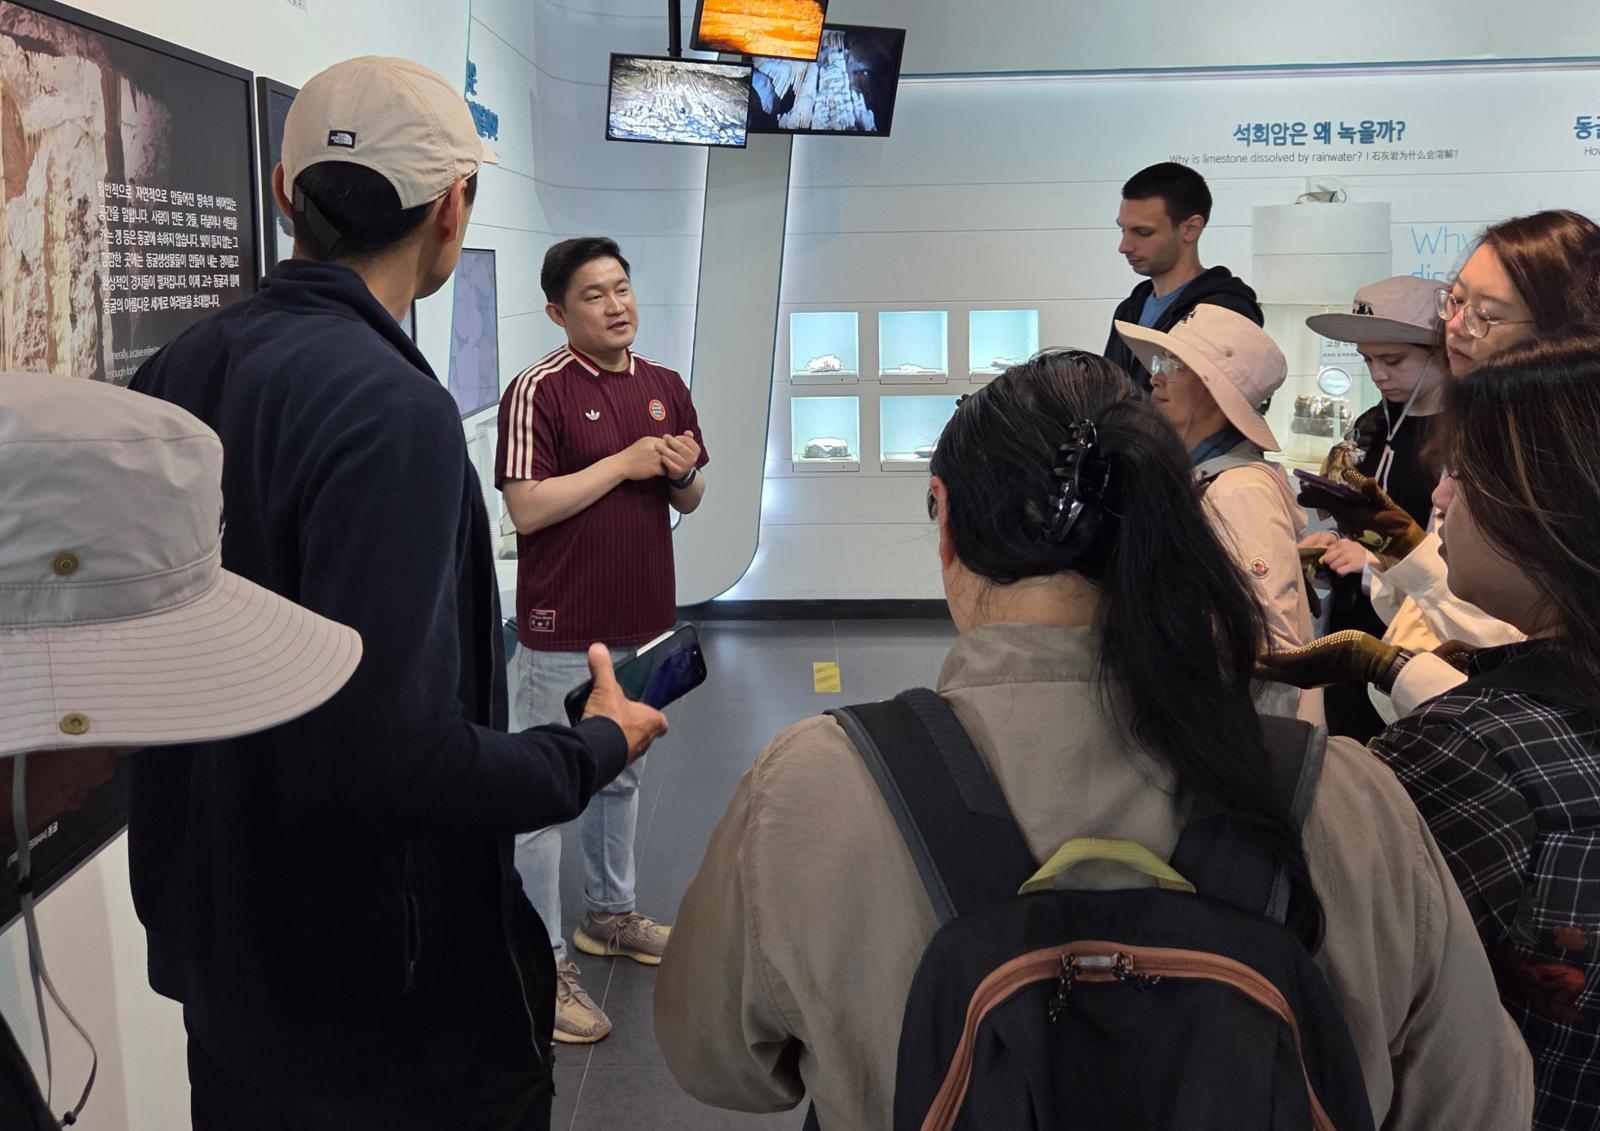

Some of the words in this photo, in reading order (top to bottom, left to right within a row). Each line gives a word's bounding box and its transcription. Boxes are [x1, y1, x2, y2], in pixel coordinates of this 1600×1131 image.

[1233, 122, 1308, 147] 석회암은
[1312, 121, 1332, 145] 왜
[1337, 119, 1406, 145] 녹을까?
[1169, 154, 1190, 164] Why
[1192, 154, 1200, 164] is
[1202, 153, 1248, 164] limestone
[1250, 152, 1295, 163] dissolved
[1298, 152, 1309, 165] by
[1312, 151, 1363, 162] rainwater?
[97, 181, 133, 200] 일반적으로
[135, 185, 168, 203] 자연적으로
[170, 190, 195, 207] 만들어진
[99, 204, 119, 222] 공간을
[121, 207, 150, 224] 말합니다.
[151, 210, 170, 226] 사람이
[171, 211, 184, 227] 만든
[123, 229, 137, 246] 등은
[137, 230, 156, 246] 동굴에
[157, 231, 175, 247] 속하지
[175, 232, 200, 248] 않습니다.
[232, 236, 239, 248] 그
[124, 252, 144, 268] 곳에는
[146, 253, 187, 268] 동굴생성물들이
[188, 254, 205, 268] 만들어
[207, 254, 218, 268] 내는
[130, 274, 156, 290] 경치들이
[188, 274, 201, 289] 이제
[201, 274, 213, 288] 고수
[213, 274, 229, 288] 동굴과
[103, 298, 123, 314] 동굴의
[124, 296, 150, 313] 아름다운
[151, 296, 169, 311] 세계로
[169, 295, 192, 310] 여러분을
